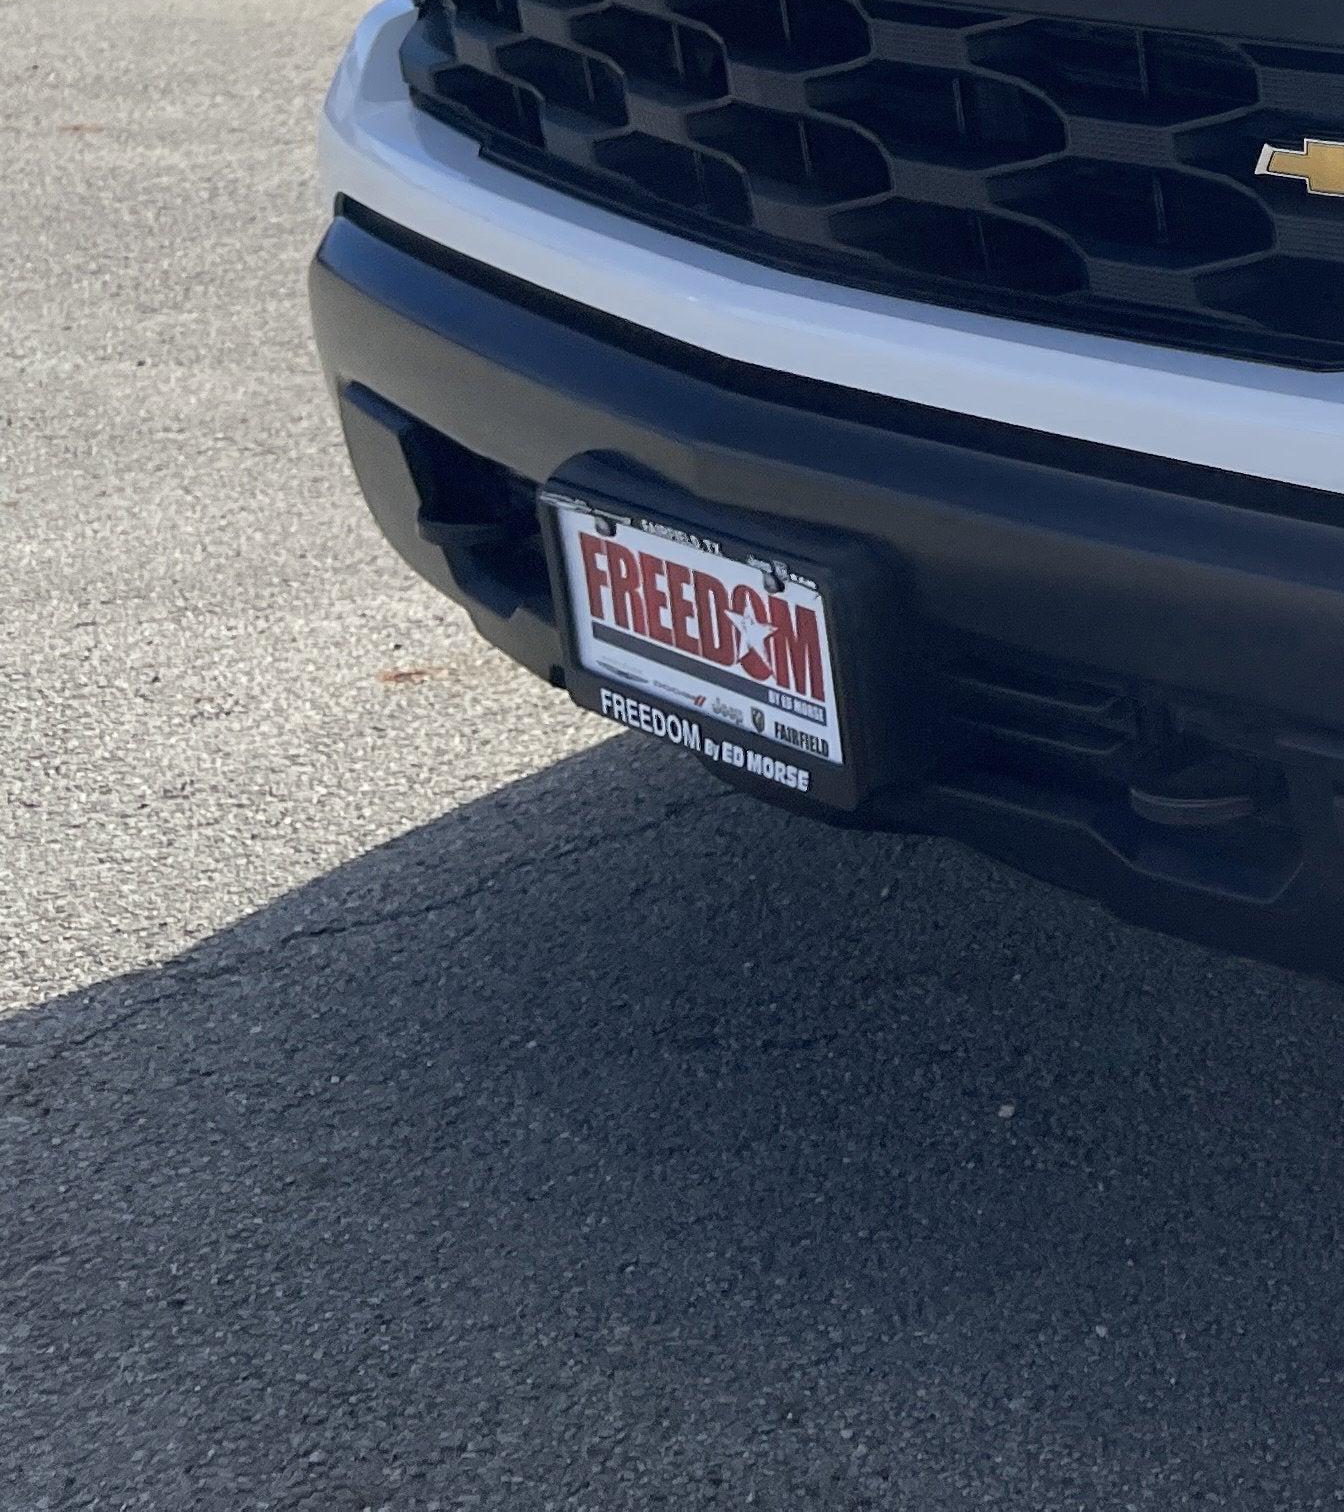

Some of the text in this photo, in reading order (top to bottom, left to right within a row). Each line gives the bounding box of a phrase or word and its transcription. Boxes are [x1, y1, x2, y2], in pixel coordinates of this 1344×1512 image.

[579, 531, 826, 702] FREEDOM
[600, 688, 701, 752] FREEDOM
[721, 740, 745, 768] ED
[746, 750, 810, 792] MORSE
[774, 721, 829, 758] FAIRFIELD
